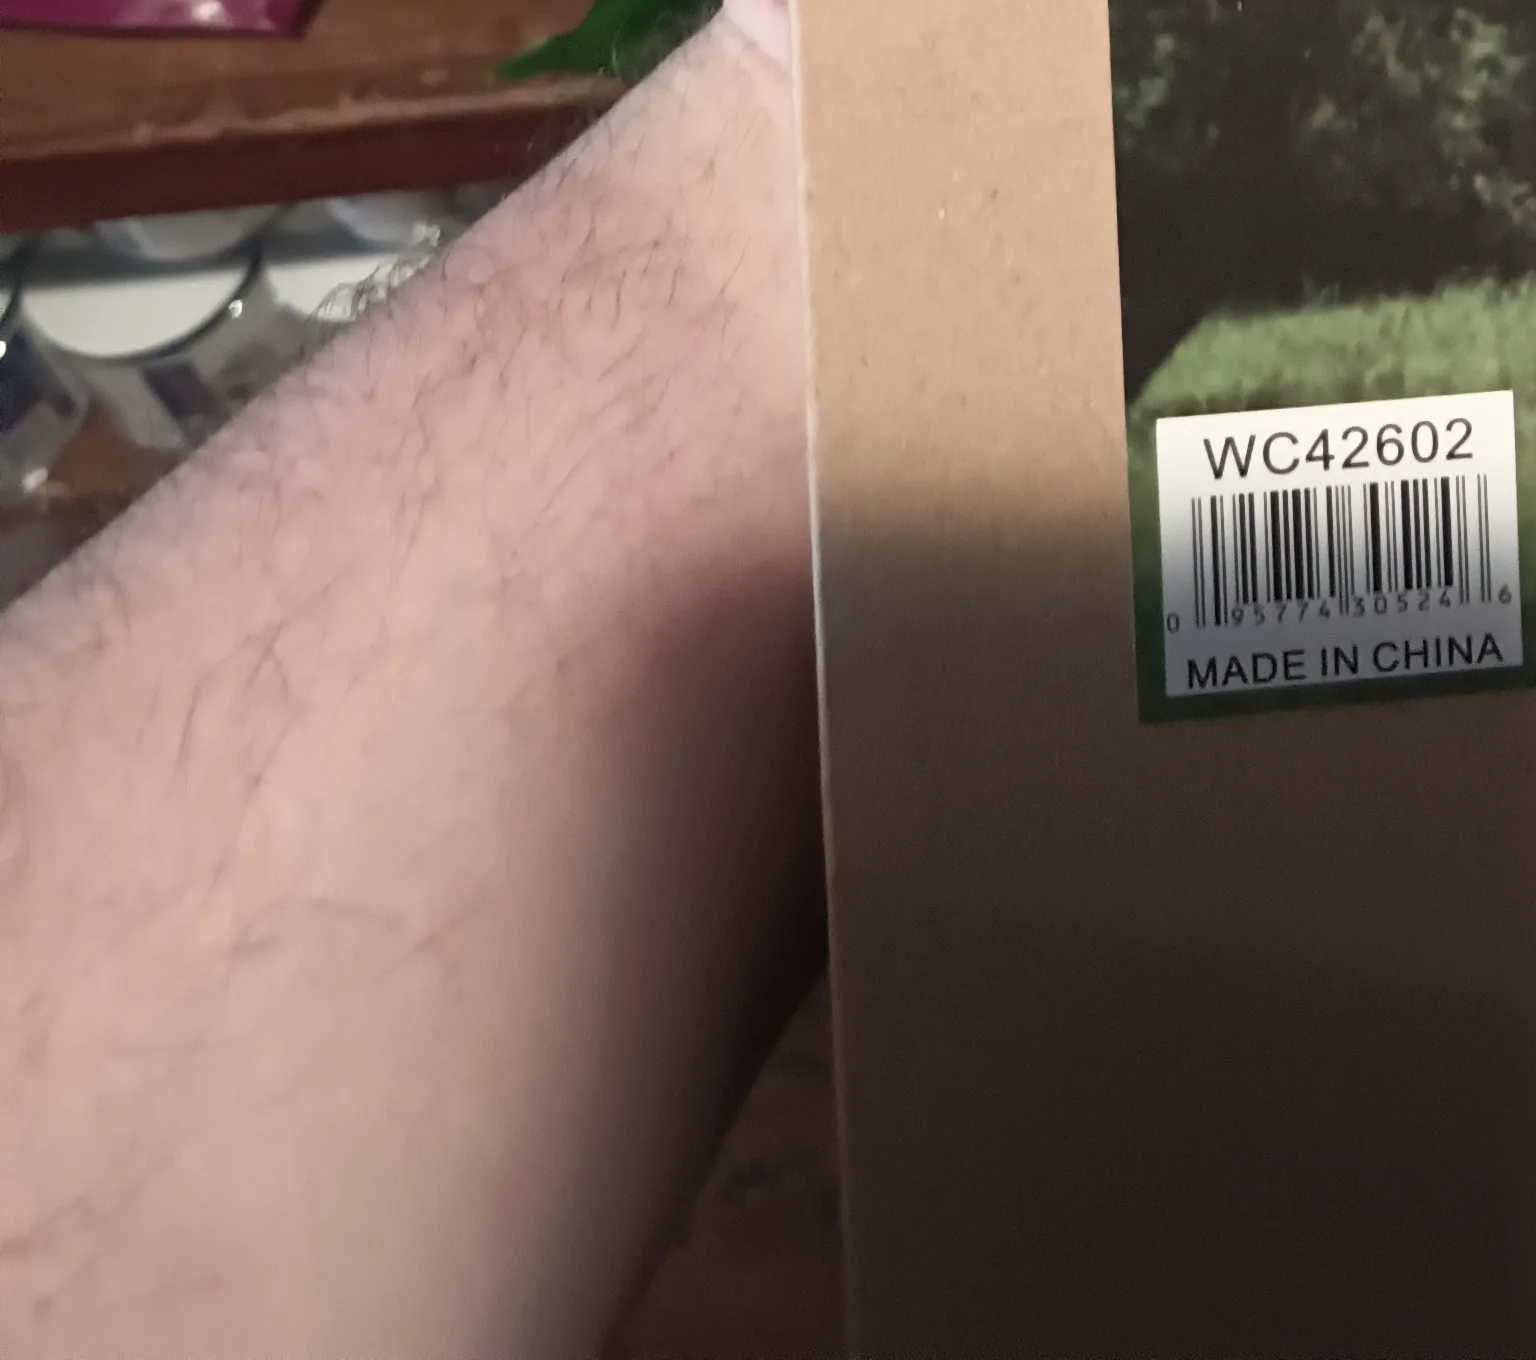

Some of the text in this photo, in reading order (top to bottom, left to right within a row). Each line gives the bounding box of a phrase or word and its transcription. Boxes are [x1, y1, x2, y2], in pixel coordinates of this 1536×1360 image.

[1203, 417, 1474, 480] WC42602
[1187, 632, 1504, 690] MADE IN CHINA
